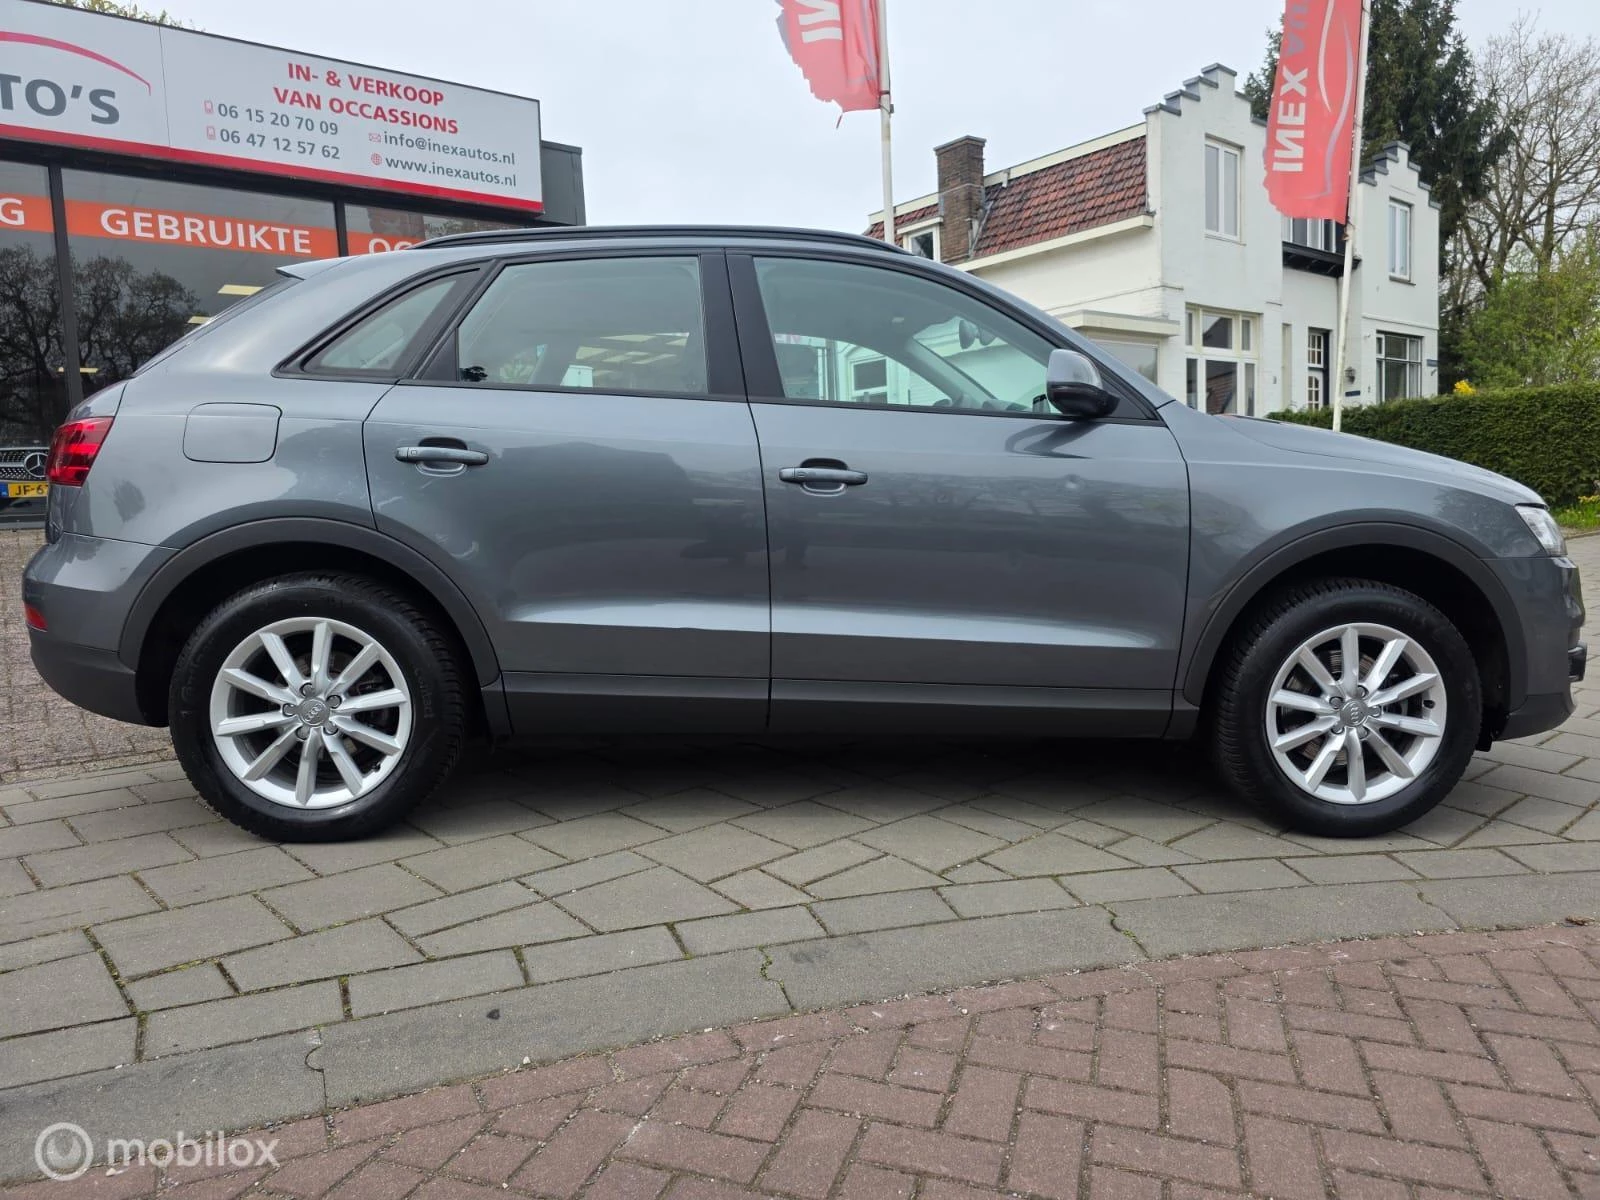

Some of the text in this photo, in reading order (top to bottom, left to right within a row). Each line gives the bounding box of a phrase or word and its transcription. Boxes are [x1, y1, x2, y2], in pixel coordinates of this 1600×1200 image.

[287, 62, 444, 107] IN- & VERKOOP
[217, 103, 339, 136] 06 15 20 70 09
[273, 86, 459, 134] VAN OCCASSIONS
[220, 128, 340, 160] 06 47 12 57 62
[384, 131, 515, 165] info@inexautos.nl
[385, 156, 517, 187] www.inexautos.nl
[100, 208, 312, 254] GEBRUIKTE
